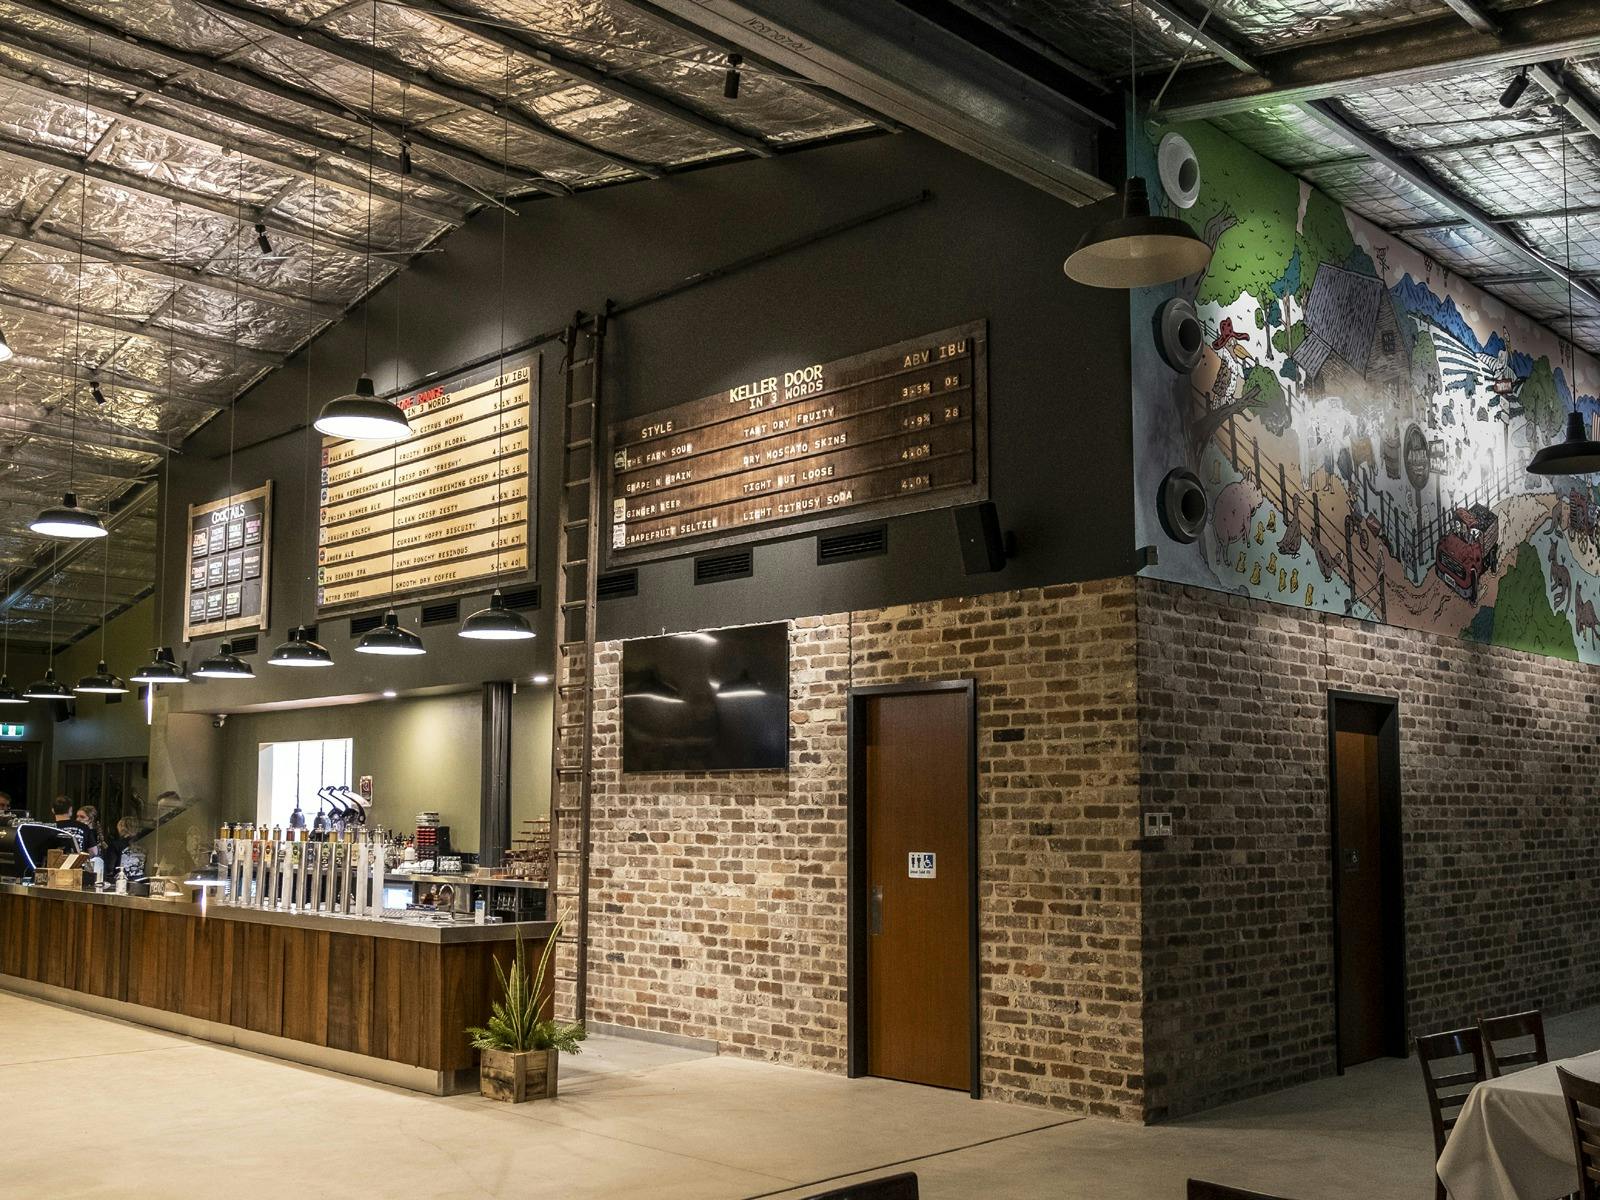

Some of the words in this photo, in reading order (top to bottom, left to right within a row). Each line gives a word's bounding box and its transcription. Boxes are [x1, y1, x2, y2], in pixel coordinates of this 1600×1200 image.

[904, 350, 929, 368] ABV
[939, 340, 965, 358] IBU
[512, 369, 528, 381] IBU
[730, 377, 777, 403] KELLER
[784, 364, 822, 387] DOOR
[749, 397, 763, 409] IN
[770, 392, 777, 403] 3
[785, 380, 823, 400] WORDS
[902, 383, 930, 397] 3.5%
[945, 377, 958, 386] 05
[407, 408, 415, 416] IN
[420, 404, 423, 412] 3
[428, 394, 451, 409] WORDS
[514, 395, 522, 403] 35
[420, 422, 441, 433] CITRUS
[445, 414, 463, 424] HOPPY
[744, 425, 767, 437] TART
[773, 419, 790, 430] DRY
[797, 407, 834, 423] FRUITY
[903, 414, 930, 426] 4.9%
[945, 409, 958, 418] 28
[641, 421, 672, 438] STYLE
[400, 450, 419, 460] FRUITY
[423, 443, 441, 453] FRESH
[445, 436, 467, 447] FLORAL
[744, 455, 760, 466] DRY
[767, 443, 808, 459] MOSCATO
[815, 434, 846, 449] SKINS
[902, 444, 929, 459] 4.0%
[330, 454, 341, 462] PALE
[627, 457, 641, 467] THE
[646, 450, 666, 463] FARM
[329, 471, 351, 481] PACIFIC
[399, 472, 416, 482] CRISP
[419, 468, 430, 476] DRY
[665, 471, 691, 485] GRAIN
[744, 480, 772, 492] TIGHT
[778, 474, 795, 488] UT
[803, 466, 833, 480] LOOSE
[329, 492, 344, 502] EXTRA
[347, 482, 378, 496] REFRESHING
[381, 479, 391, 487] ALE
[398, 490, 426, 502] HONEYDEW
[429, 481, 466, 495] REFRESHING
[469, 475, 488, 484] CRISP
[328, 512, 346, 522] INDIAN
[349, 506, 367, 516] SUMMER
[627, 506, 655, 518] GINGER
[744, 508, 771, 521] LIGHT
[778, 498, 820, 513] CITRUSY
[827, 490, 852, 504] SODA
[398, 516, 415, 525] CLEAN
[418, 509, 436, 519] CRISP
[440, 505, 458, 514] ZESTY
[328, 532, 348, 542] DRAUGHT
[352, 527, 371, 535] KOLSCH
[397, 536, 421, 546] CURRANT
[425, 531, 442, 539] HOPPY
[446, 524, 476, 535] BISCUITY
[626, 526, 676, 544] GRAPEFRUIT
[681, 516, 718, 534] SELTZE
[327, 554, 341, 562] AMBER
[397, 559, 410, 567] DANK
[438, 547, 468, 558] RESINOUS
[335, 571, 354, 580] SEASON
[396, 580, 416, 589] SMOOTH
[420, 576, 430, 584] DRY
[434, 572, 456, 581] COFFEE
[325, 594, 341, 602] NITRO
[344, 590, 359, 599] STOUT
